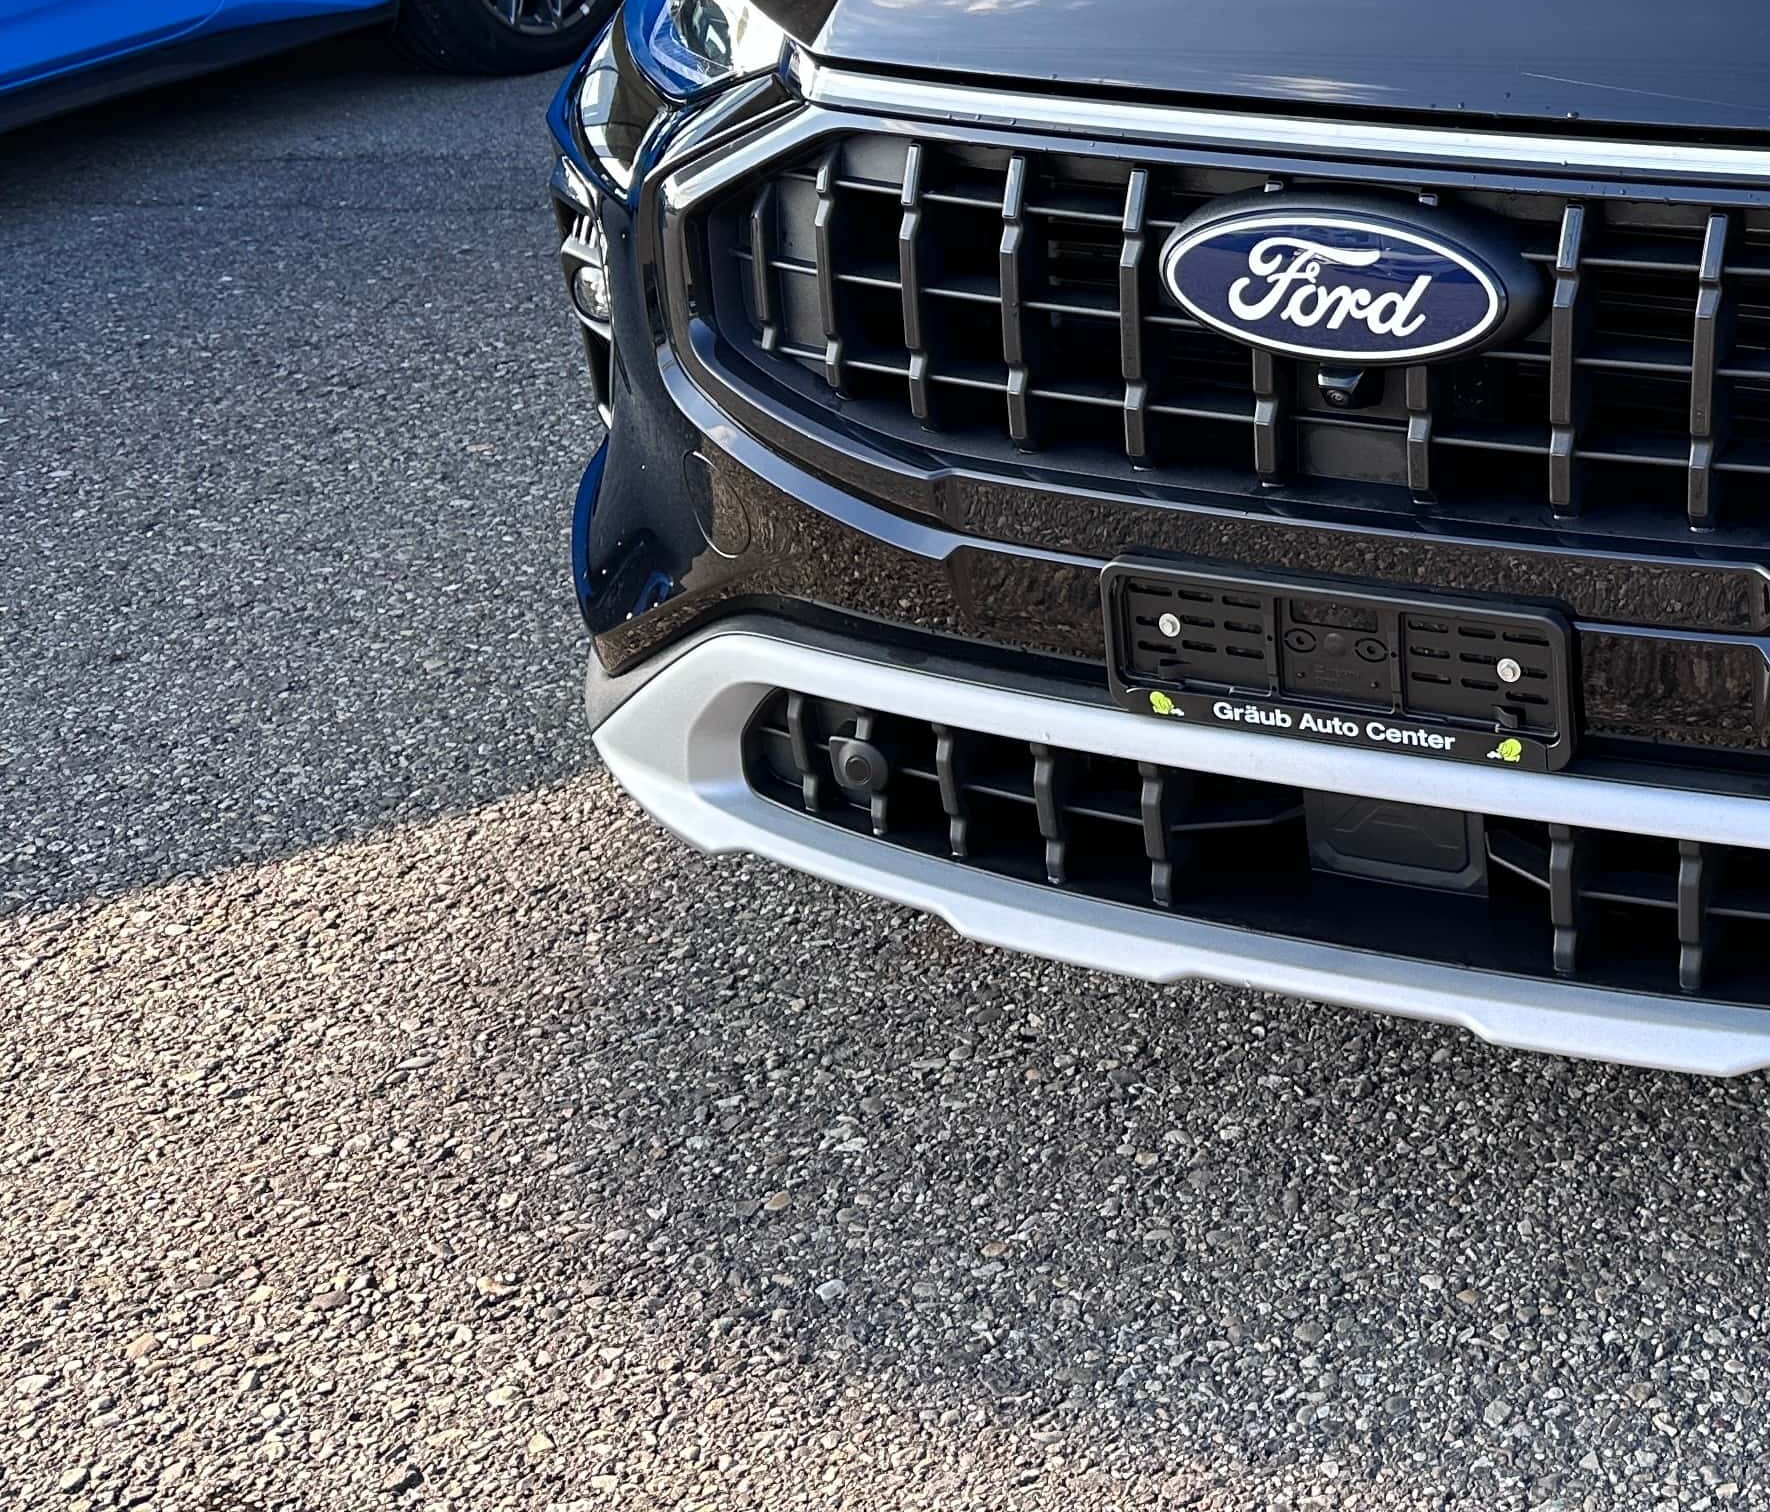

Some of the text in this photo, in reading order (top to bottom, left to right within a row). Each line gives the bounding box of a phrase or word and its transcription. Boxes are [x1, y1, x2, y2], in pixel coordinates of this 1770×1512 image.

[1228, 236, 1432, 338] Ford
[1213, 701, 1456, 751] Gräub Auto Center
